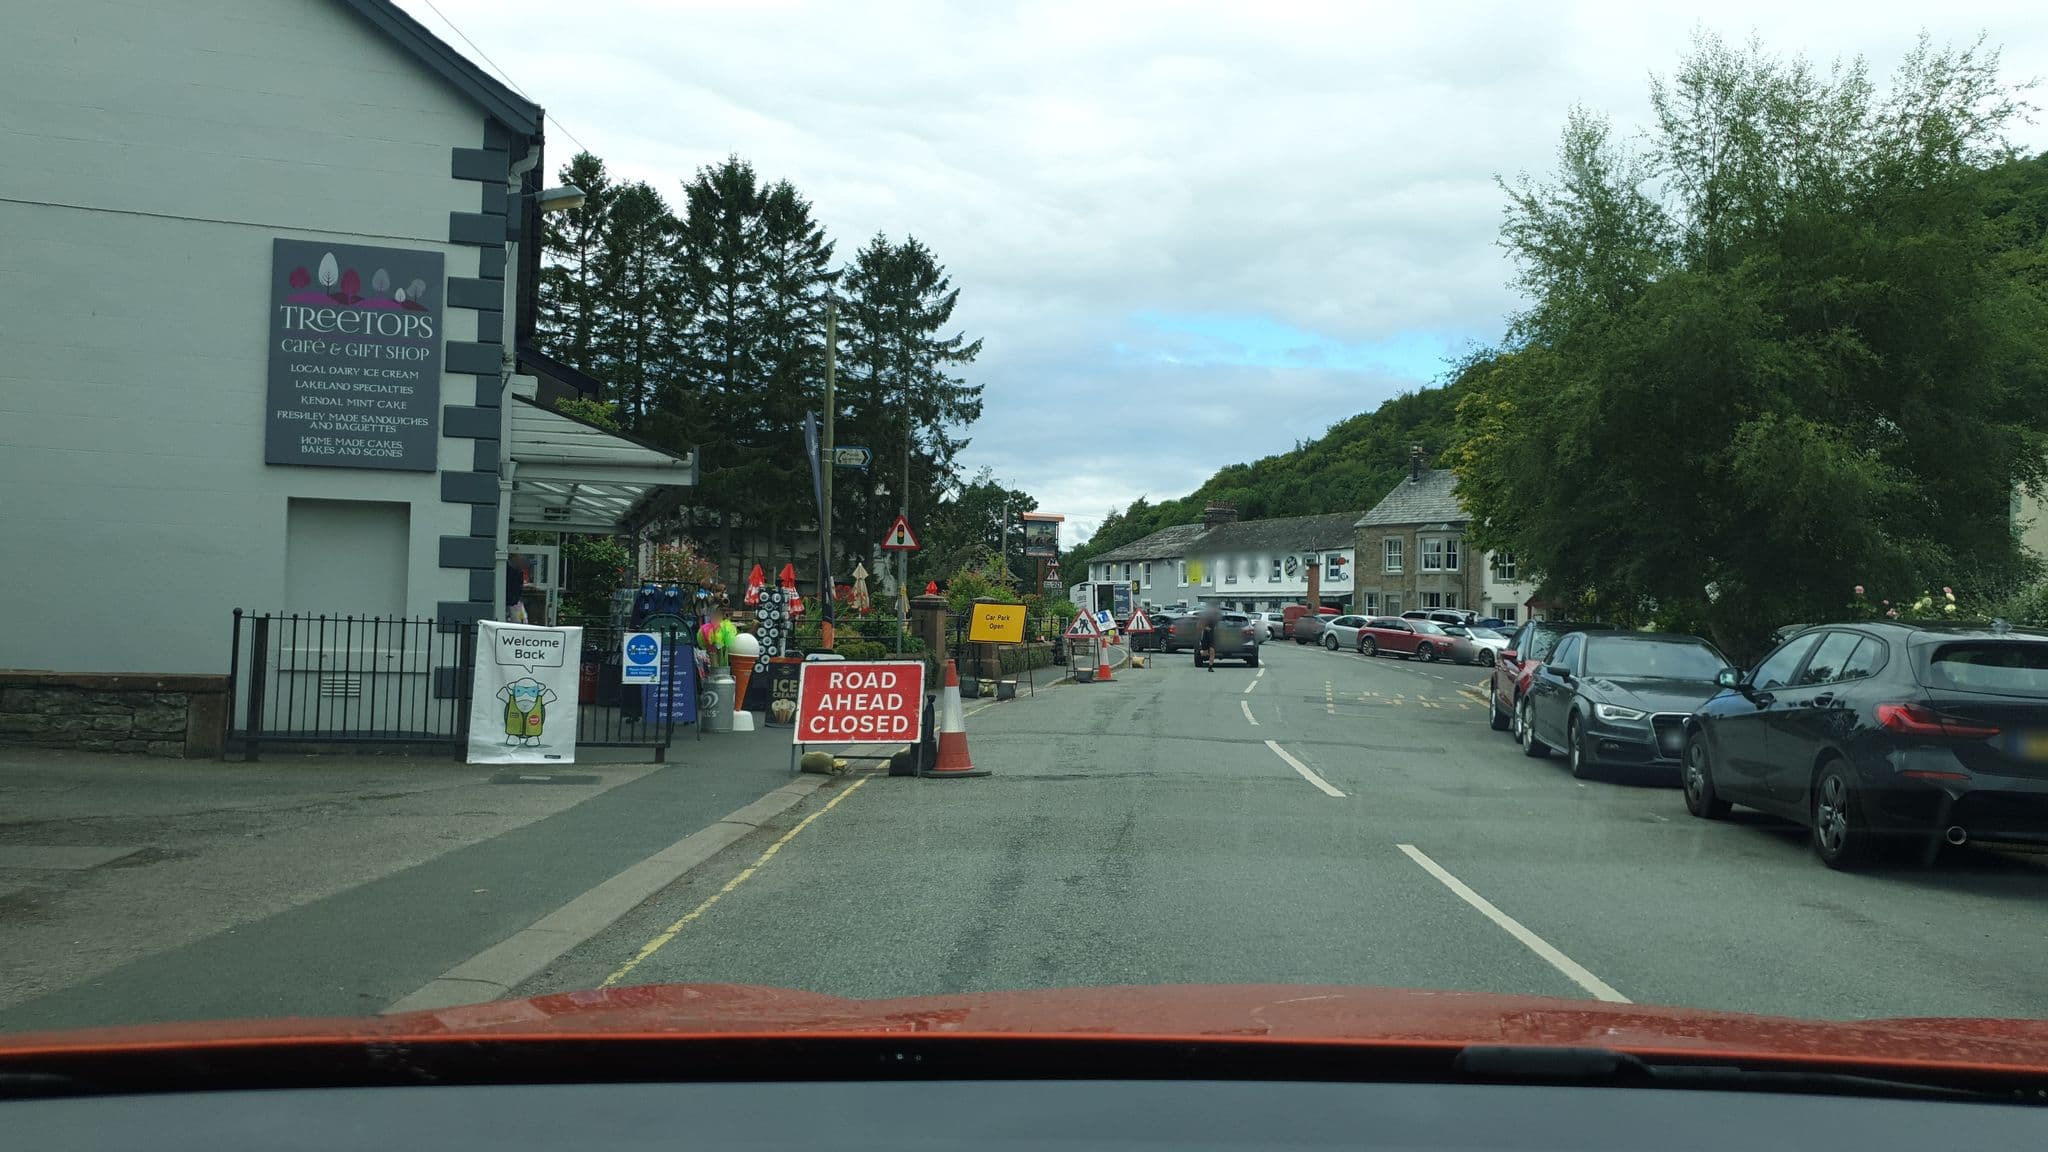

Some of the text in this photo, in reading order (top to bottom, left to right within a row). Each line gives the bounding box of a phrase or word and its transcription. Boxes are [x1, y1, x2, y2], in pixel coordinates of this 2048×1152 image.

[330, 343, 341, 356] &
[345, 343, 382, 358] GIFT
[386, 346, 429, 360] SHOP
[291, 364, 419, 379] LOCAL DAIRY ICE CREAM
[295, 380, 414, 395] LAKELAND SPECIALTIES
[301, 396, 407, 410] KENDAL MINT CAKE
[329, 413, 359, 422] MADE
[361, 415, 429, 426] SANDWICHES
[310, 422, 397, 433] AND BAGUETTES
[301, 436, 403, 449] HOME MADE CAKES
[301, 445, 403, 457] BAKES AND SCONES
[502, 635, 560, 648] Welcome
[514, 649, 545, 660] Back
[772, 678, 798, 693] ICE
[829, 671, 897, 689] ROAD
[818, 693, 903, 711] AHEAD
[809, 715, 909, 734] CLOSED
